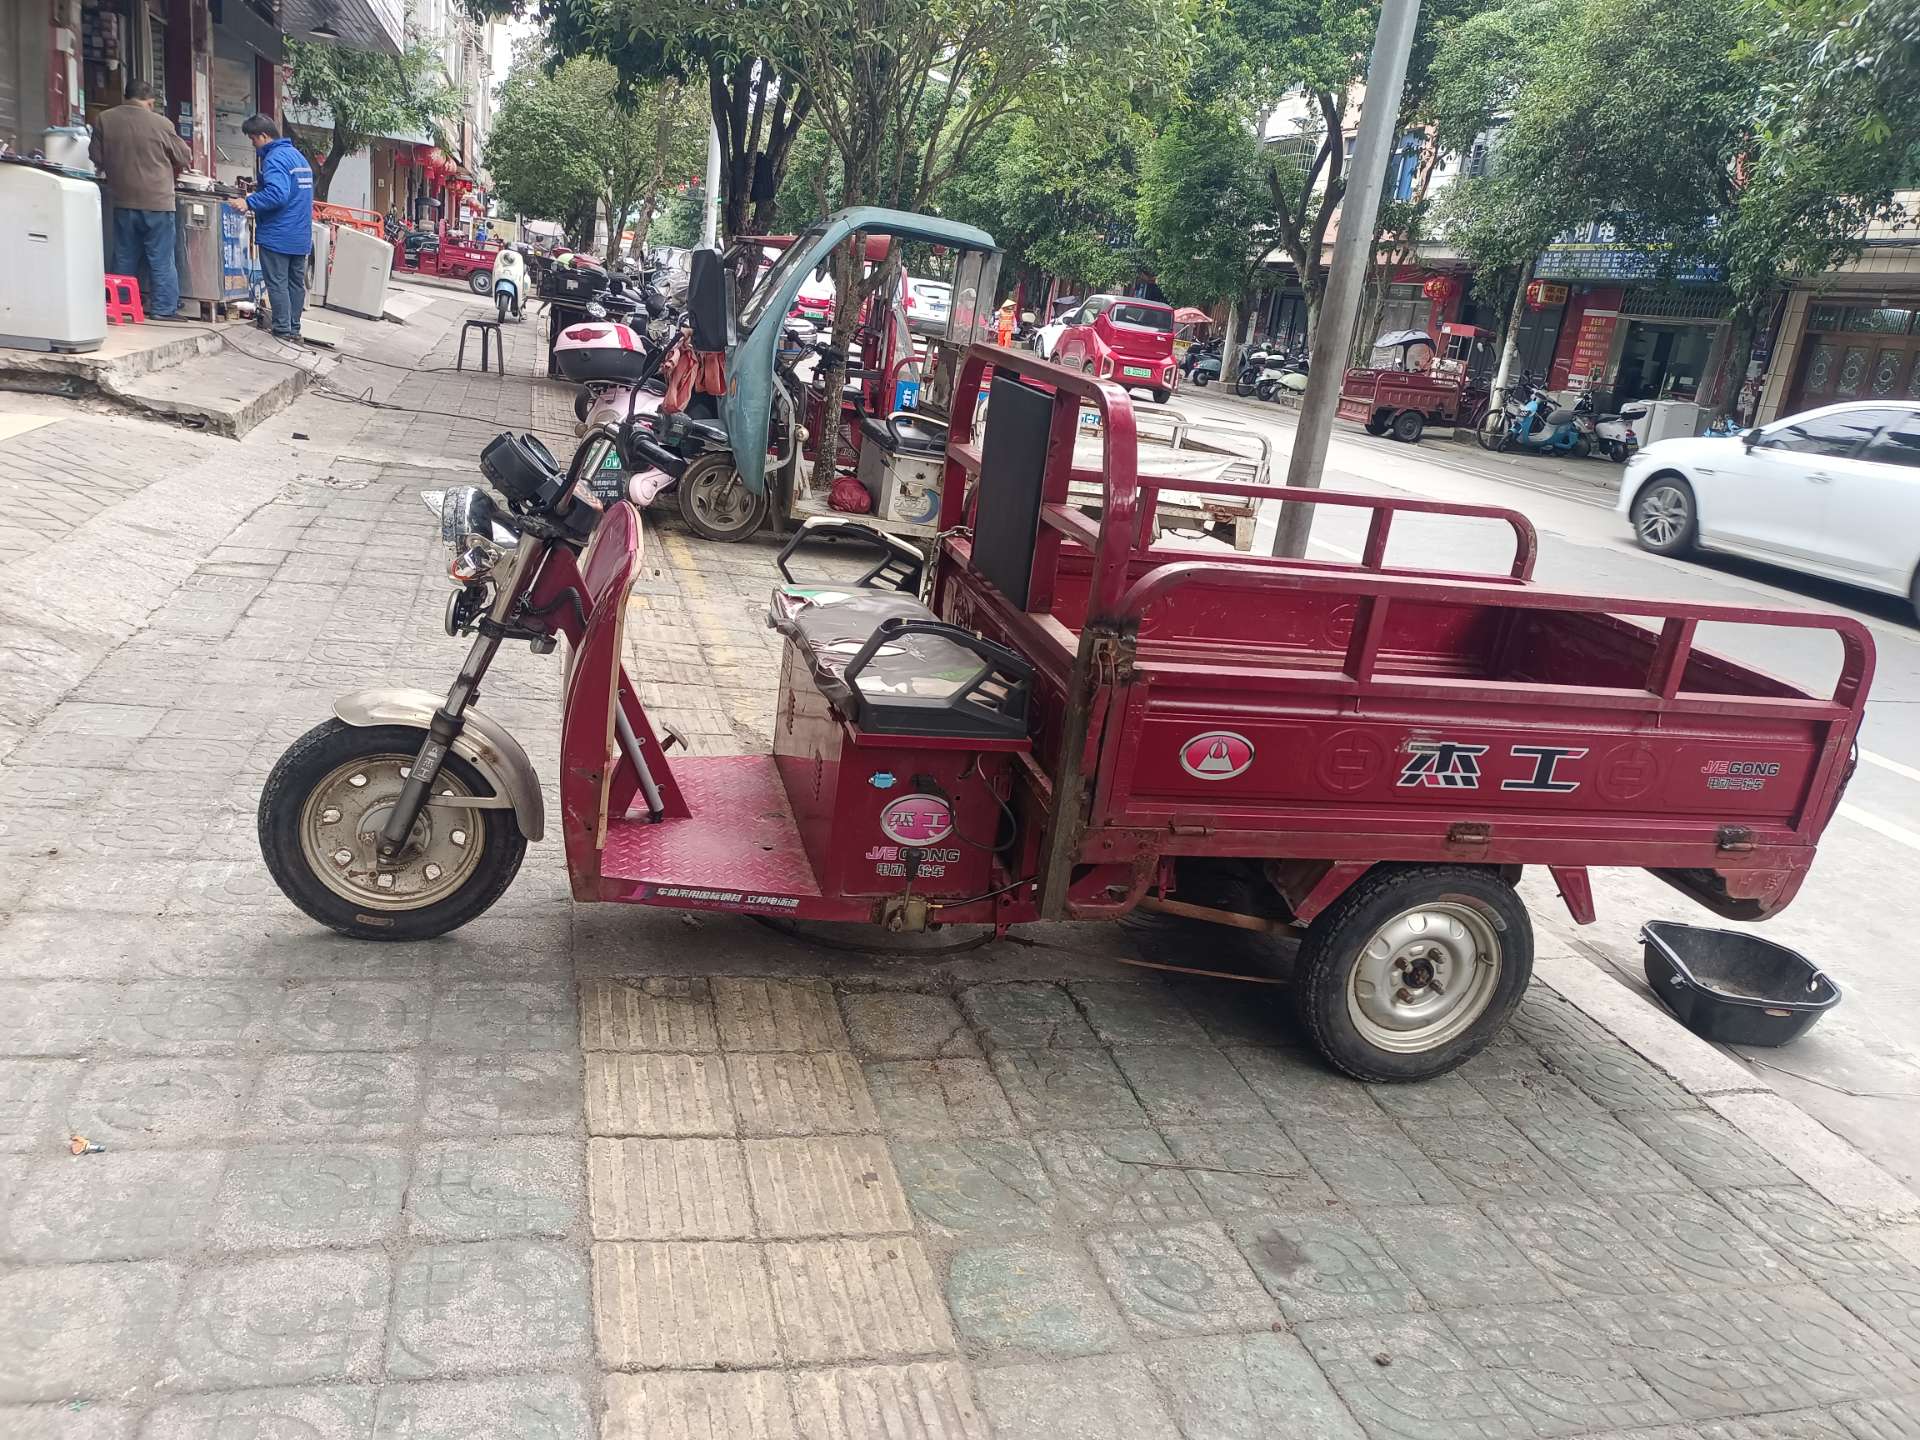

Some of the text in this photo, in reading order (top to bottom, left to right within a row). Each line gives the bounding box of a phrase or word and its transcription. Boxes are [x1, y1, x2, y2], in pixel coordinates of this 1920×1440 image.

[1397, 741, 1589, 792] 杰工
[1707, 777, 1766, 790] 电动三轮车
[889, 811, 950, 829] 杰工
[876, 863, 945, 877] 电动轮车
